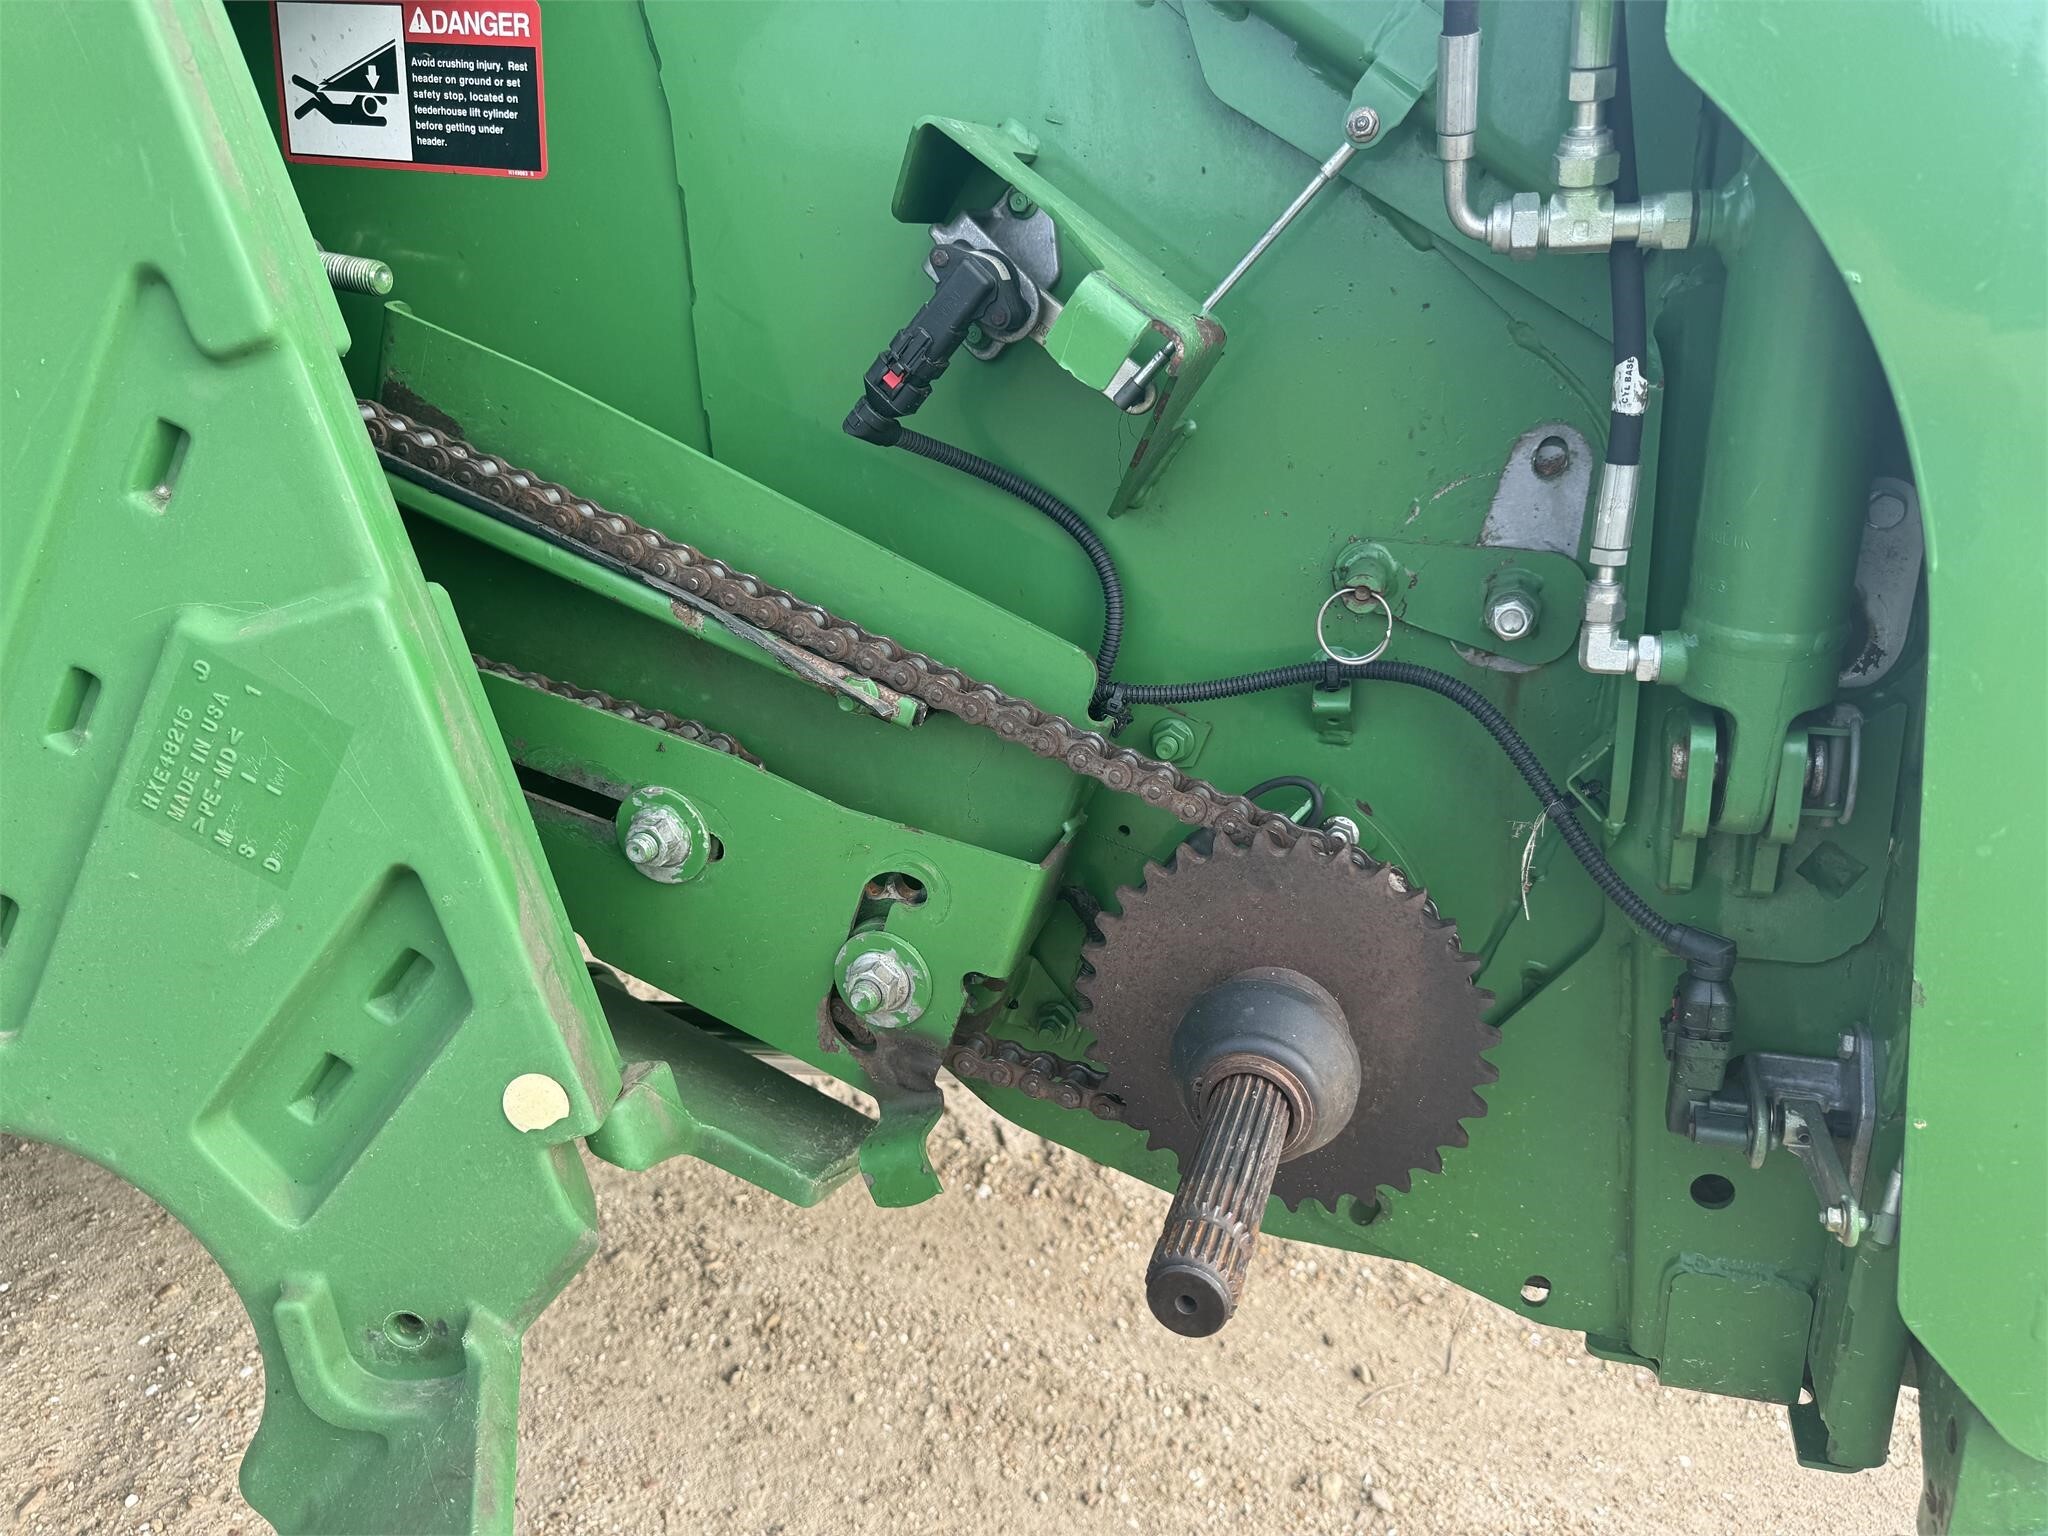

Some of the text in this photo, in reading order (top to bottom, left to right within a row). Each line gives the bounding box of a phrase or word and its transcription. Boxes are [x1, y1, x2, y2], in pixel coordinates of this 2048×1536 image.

[431, 10, 530, 37] DANGER
[411, 57, 528, 73] Avoid crushing injury. Rest
[412, 73, 521, 88] header on ground or set
[413, 90, 519, 104] safety stop, located on
[414, 105, 518, 120] feederhouse lift cylinder
[415, 120, 504, 135] before getting under
[416, 136, 448, 147] header.
[1621, 358, 1635, 404] CYL BASE
[166, 691, 231, 822] MADE IN USA
